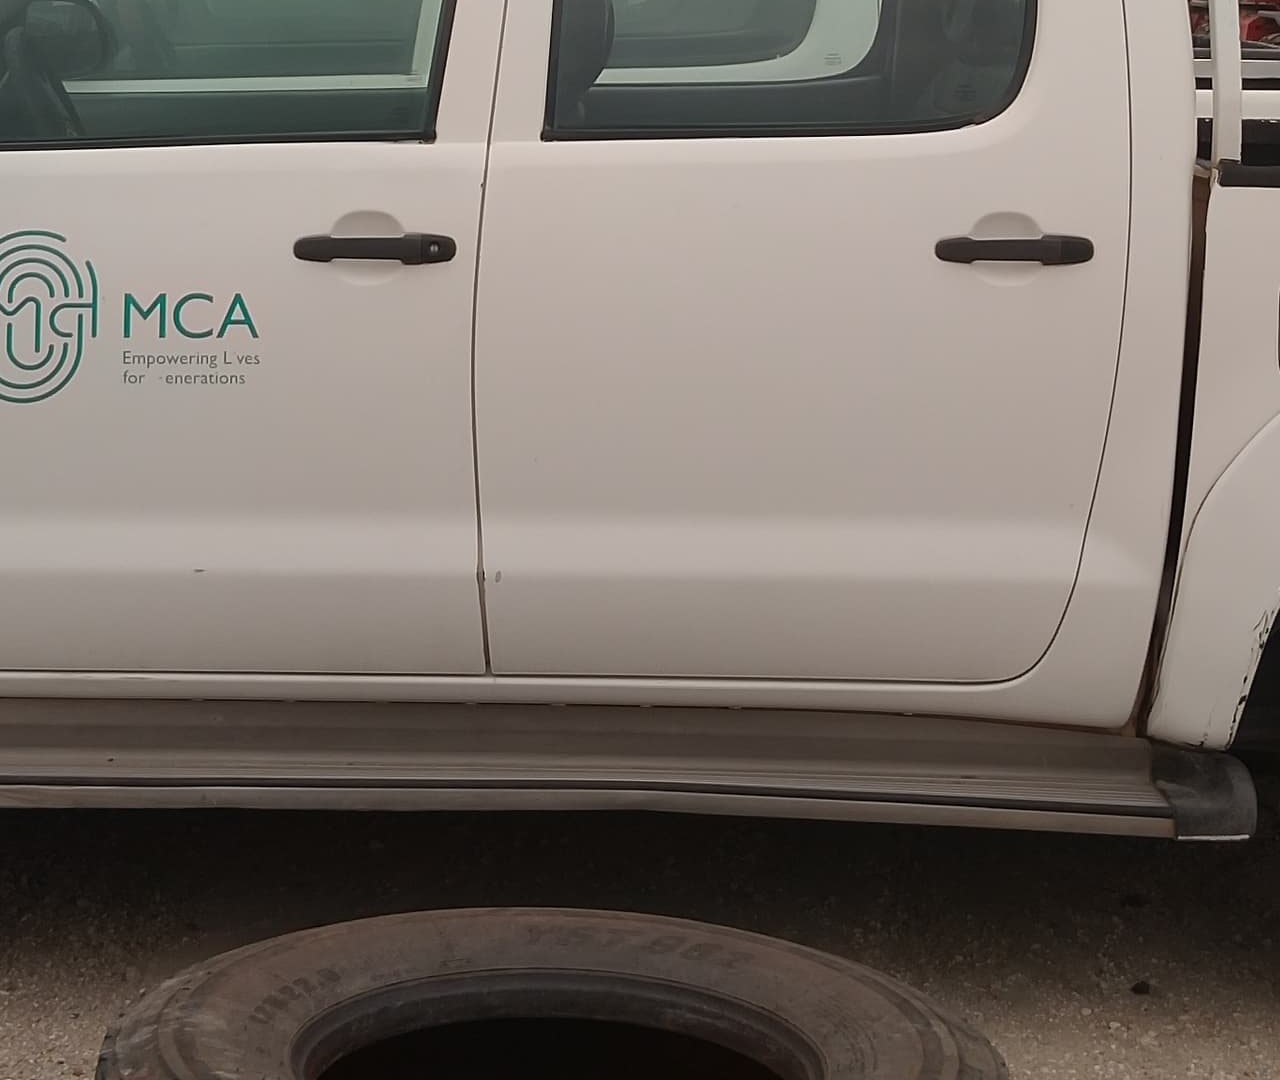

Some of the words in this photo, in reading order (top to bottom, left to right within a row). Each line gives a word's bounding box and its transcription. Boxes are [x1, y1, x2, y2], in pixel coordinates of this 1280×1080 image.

[123, 292, 260, 339] MCA
[122, 350, 218, 369] Empowering
[223, 350, 261, 365] Lves
[123, 369, 146, 385] for
[158, 371, 246, 385] enerations
